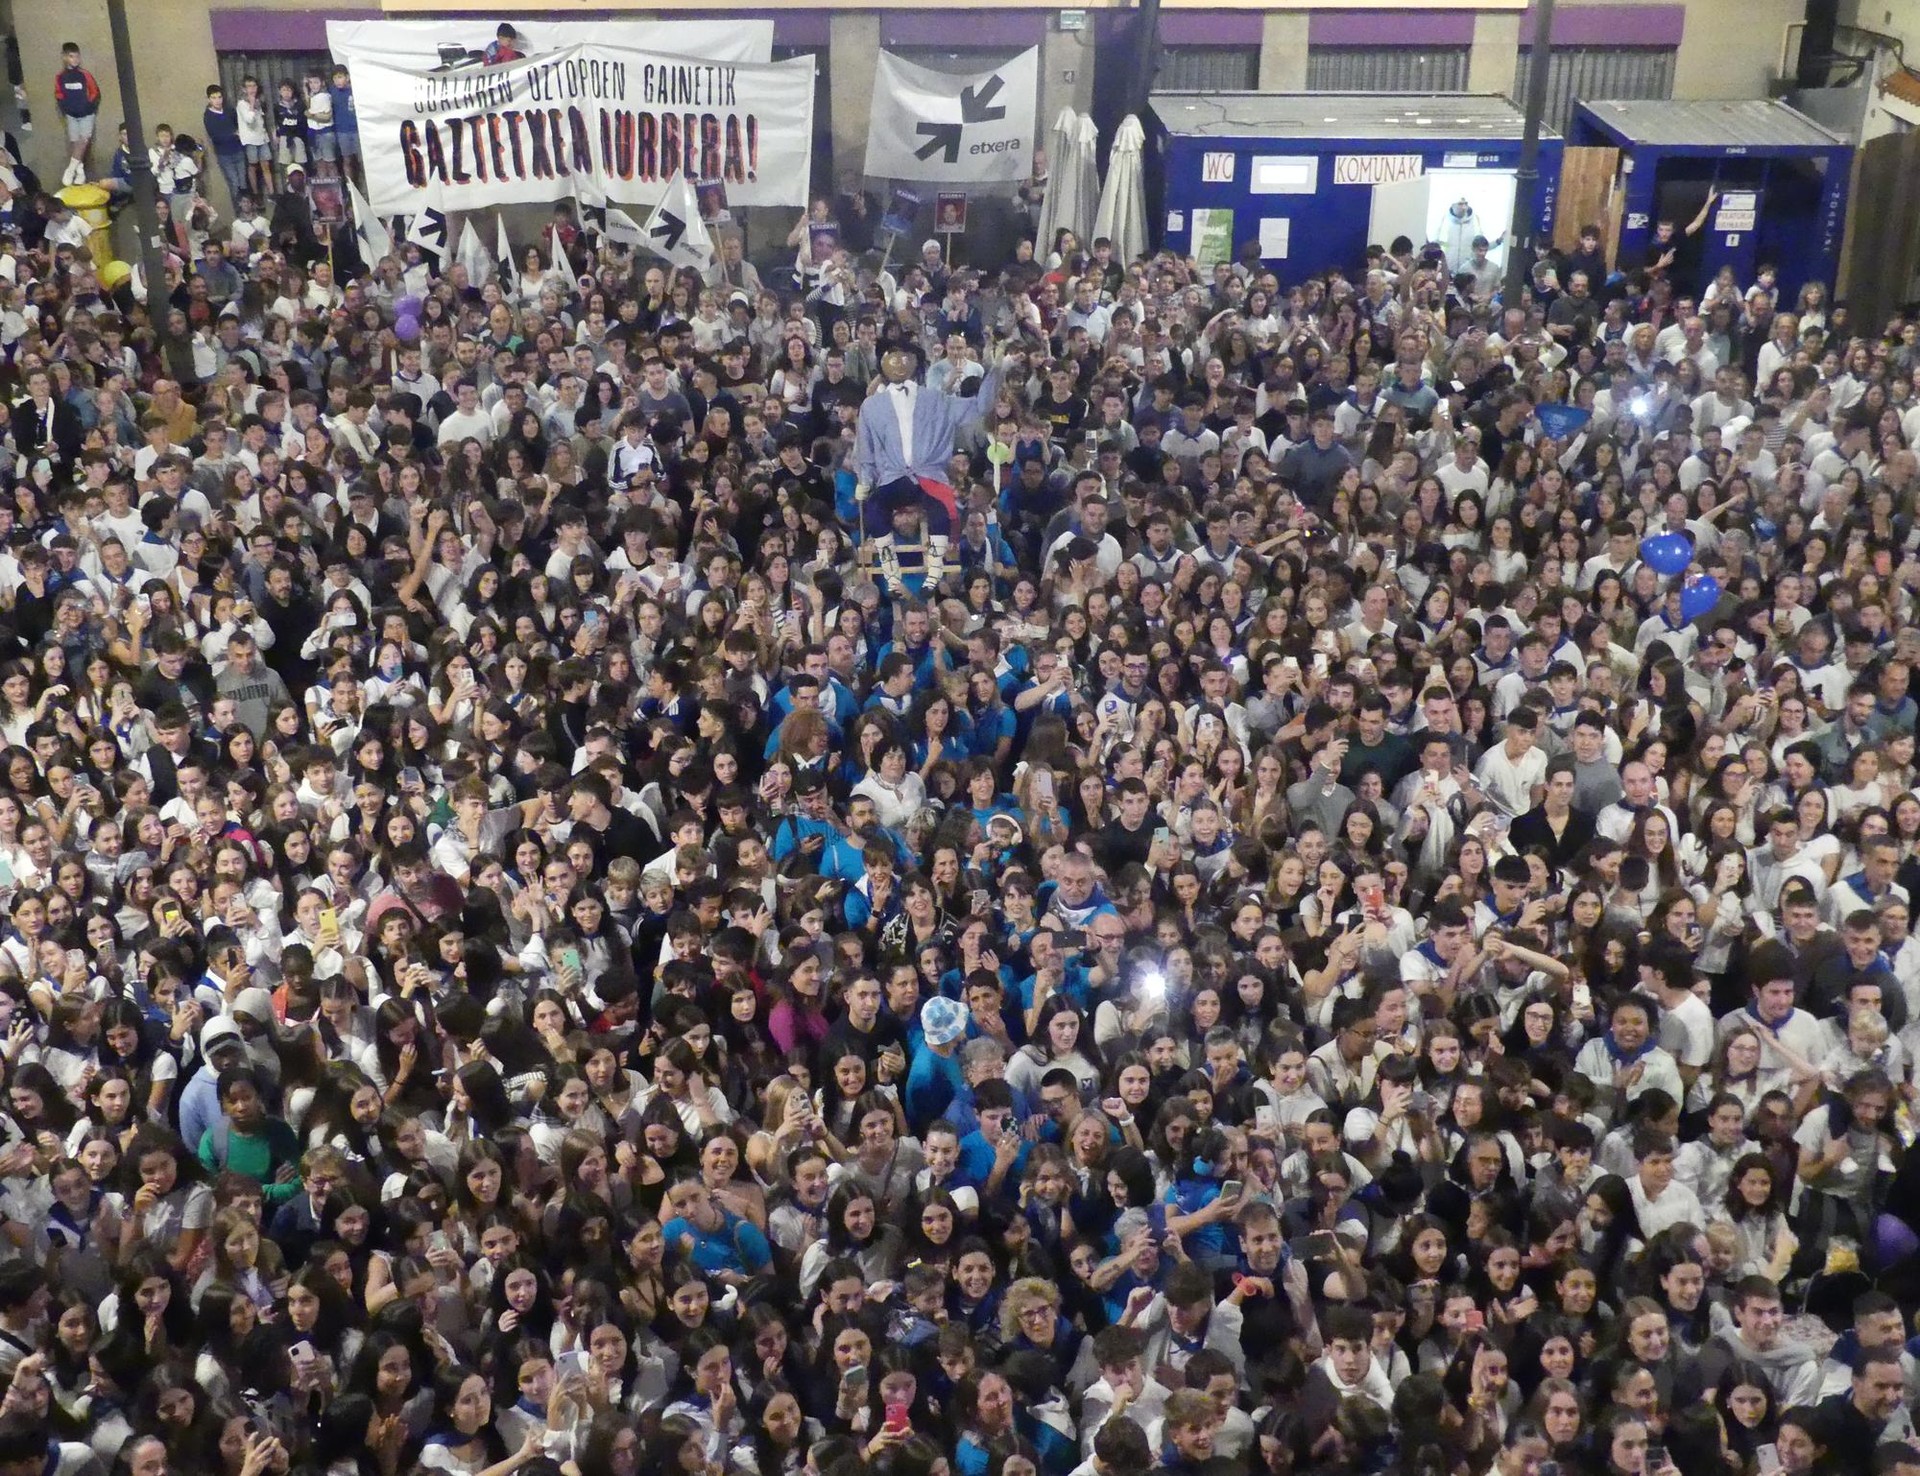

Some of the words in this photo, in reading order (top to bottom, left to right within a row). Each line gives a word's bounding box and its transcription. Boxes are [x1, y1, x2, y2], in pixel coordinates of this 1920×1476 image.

[643, 64, 736, 105] GAINETIK
[400, 105, 593, 188] GAZTETXEA
[969, 138, 1021, 155] etxera
[1206, 153, 1233, 180] WC
[1336, 156, 1421, 183] KOMUNAK
